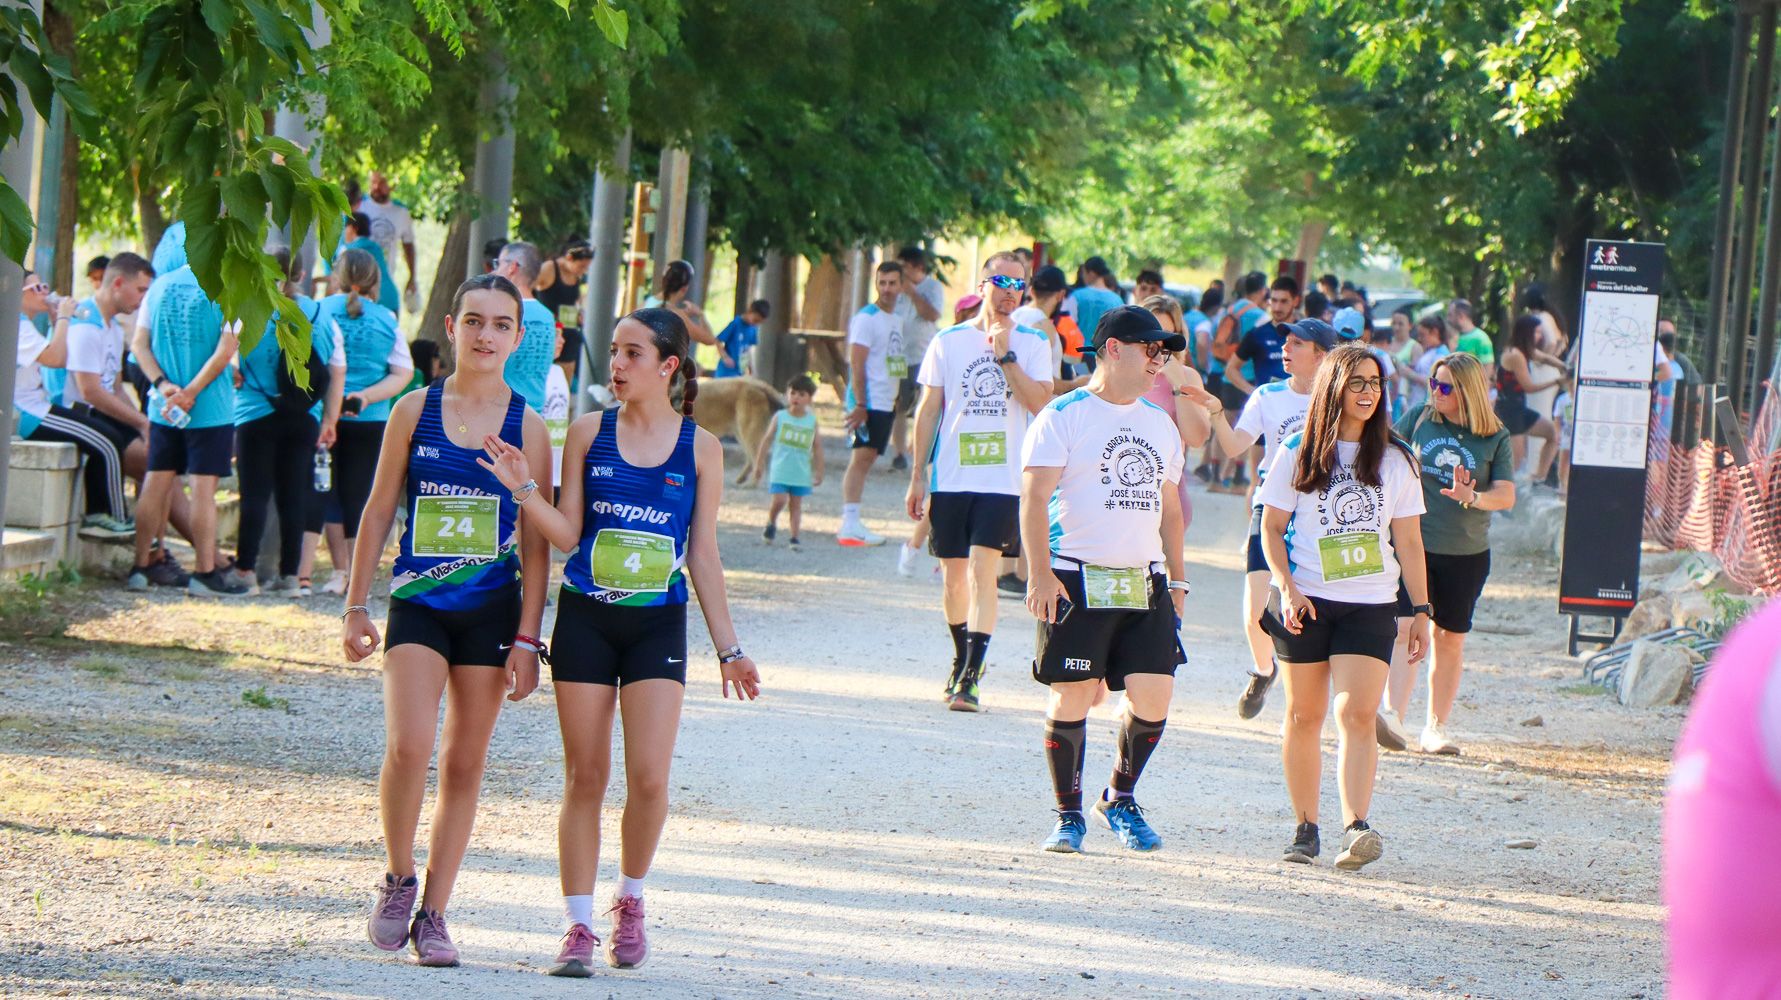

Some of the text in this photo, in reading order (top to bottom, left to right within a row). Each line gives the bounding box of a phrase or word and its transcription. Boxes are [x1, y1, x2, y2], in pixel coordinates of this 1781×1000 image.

[426, 451, 440, 459] PRO
[969, 442, 999, 457] 173
[1102, 434, 1130, 460] CARRERA
[1132, 435, 1165, 475] MEMORIAL
[1109, 488, 1158, 500] JOSÉ SILLERO
[1318, 473, 1353, 501] CARRERA
[592, 500, 673, 525] enerplus
[1119, 500, 1151, 508] KEYTER
[437, 515, 475, 538] 24
[624, 552, 643, 574] 4
[1341, 546, 1367, 566] 10
[1105, 578, 1132, 595] 25
[1065, 657, 1091, 671] PETER
